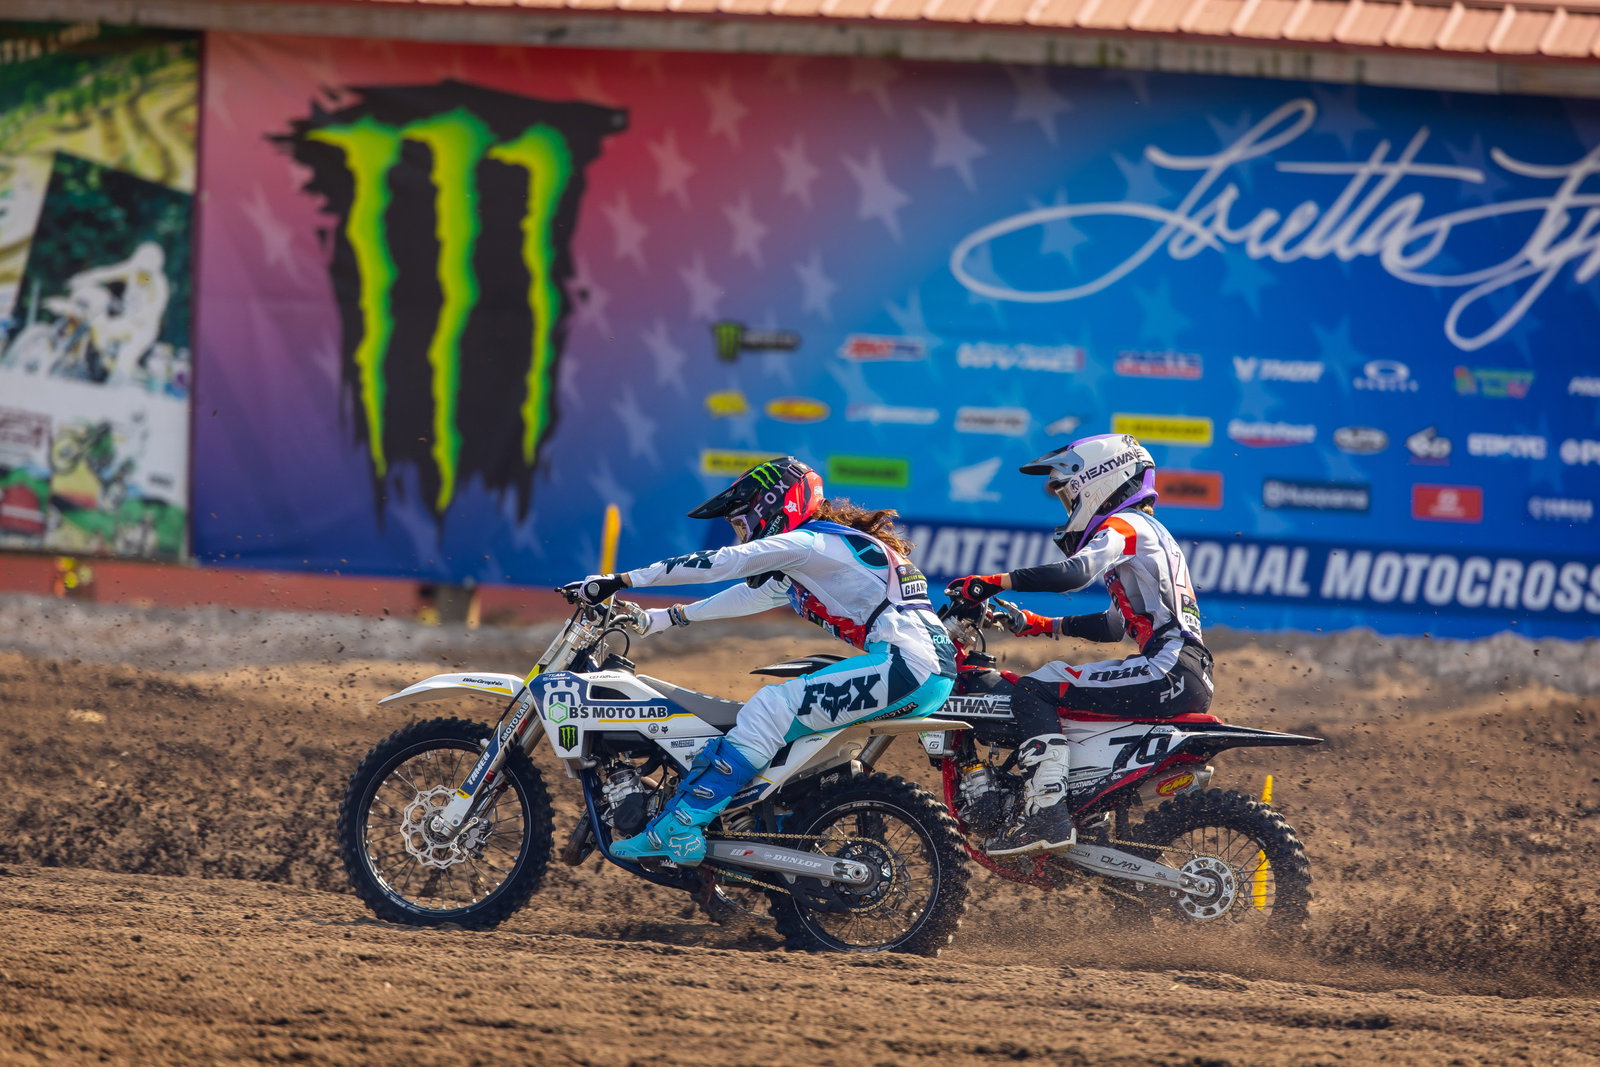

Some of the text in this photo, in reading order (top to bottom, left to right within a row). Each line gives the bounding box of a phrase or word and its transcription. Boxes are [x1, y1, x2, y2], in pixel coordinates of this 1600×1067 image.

[949, 97, 1484, 303] Loretta
[753, 479, 791, 518] FOX
[764, 515, 783, 538] NSTER
[1180, 540, 1311, 597] ONAL
[797, 673, 881, 722] FOX
[937, 698, 1011, 715] ATWAVE
[1160, 676, 1185, 703] FLY
[500, 702, 529, 742] MOTO LAB
[592, 707, 635, 719] MOTO
[639, 706, 667, 718] LAB
[1108, 734, 1173, 772] 70
[772, 854, 822, 869] DUNLOP
